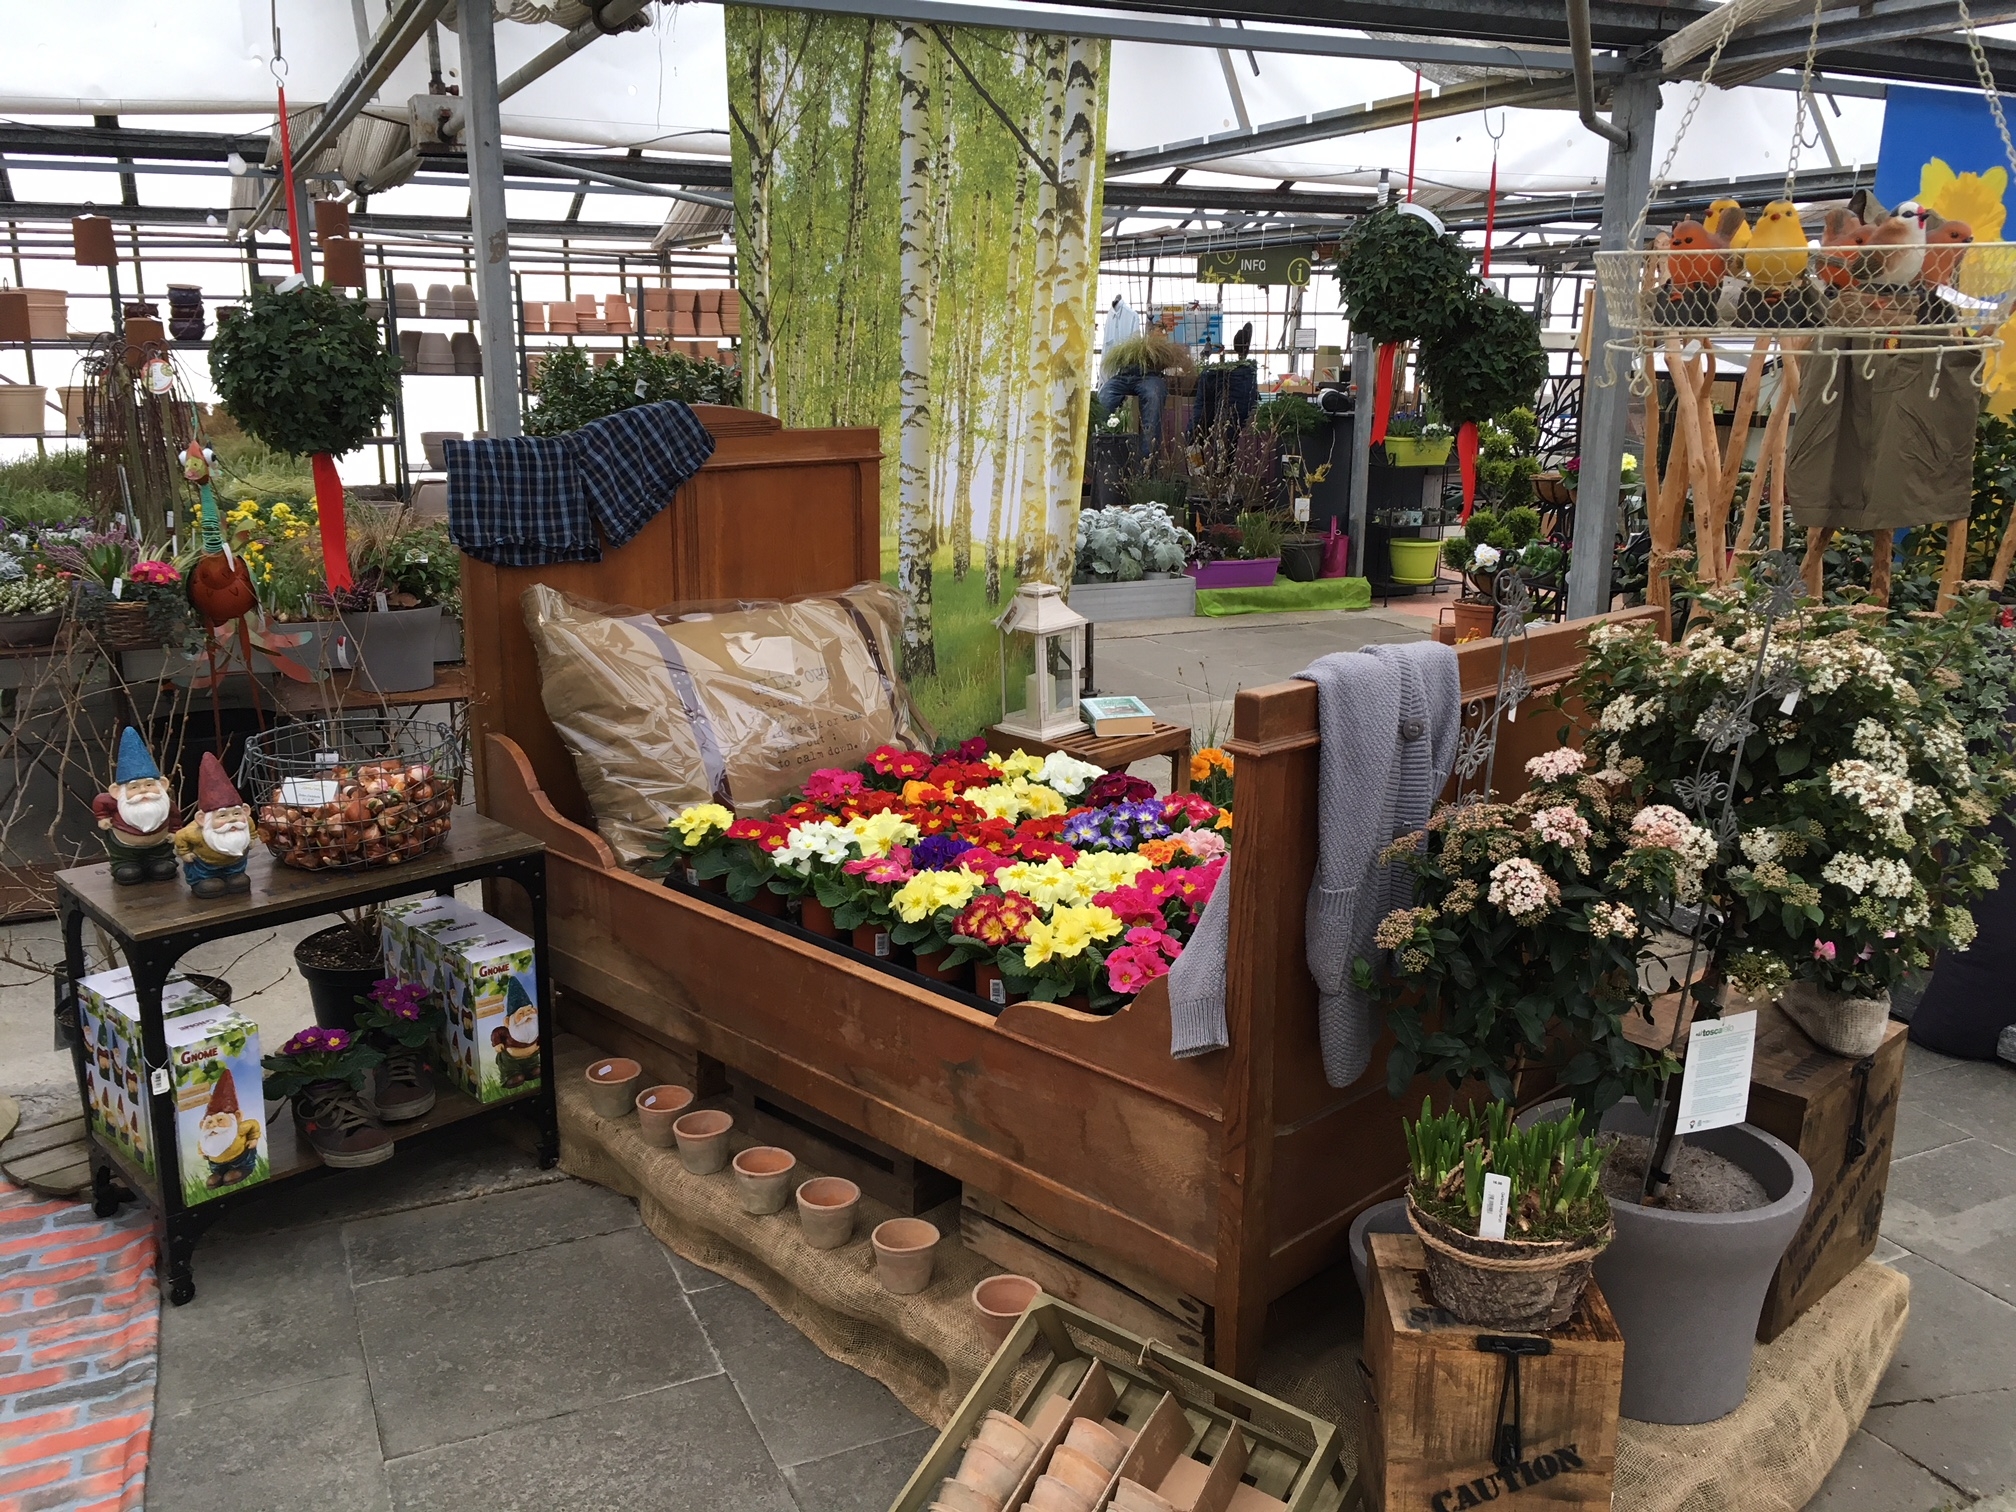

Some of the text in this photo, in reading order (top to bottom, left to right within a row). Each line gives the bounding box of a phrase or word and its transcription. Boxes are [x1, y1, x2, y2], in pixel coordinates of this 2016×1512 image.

[1241, 259, 1266, 271] INFO
[789, 721, 824, 735] relax
[827, 717, 839, 728] or
[806, 736, 825, 747] out
[778, 743, 859, 769] to calm down.
[413, 905, 445, 915] GNOME
[447, 921, 479, 932] GNOME
[477, 938, 509, 949] GNOME
[479, 963, 510, 978] GNOME
[178, 1018, 218, 1032] GNOME
[180, 1047, 219, 1065] GNOME
[1431, 1444, 1584, 1512] CAUTION
